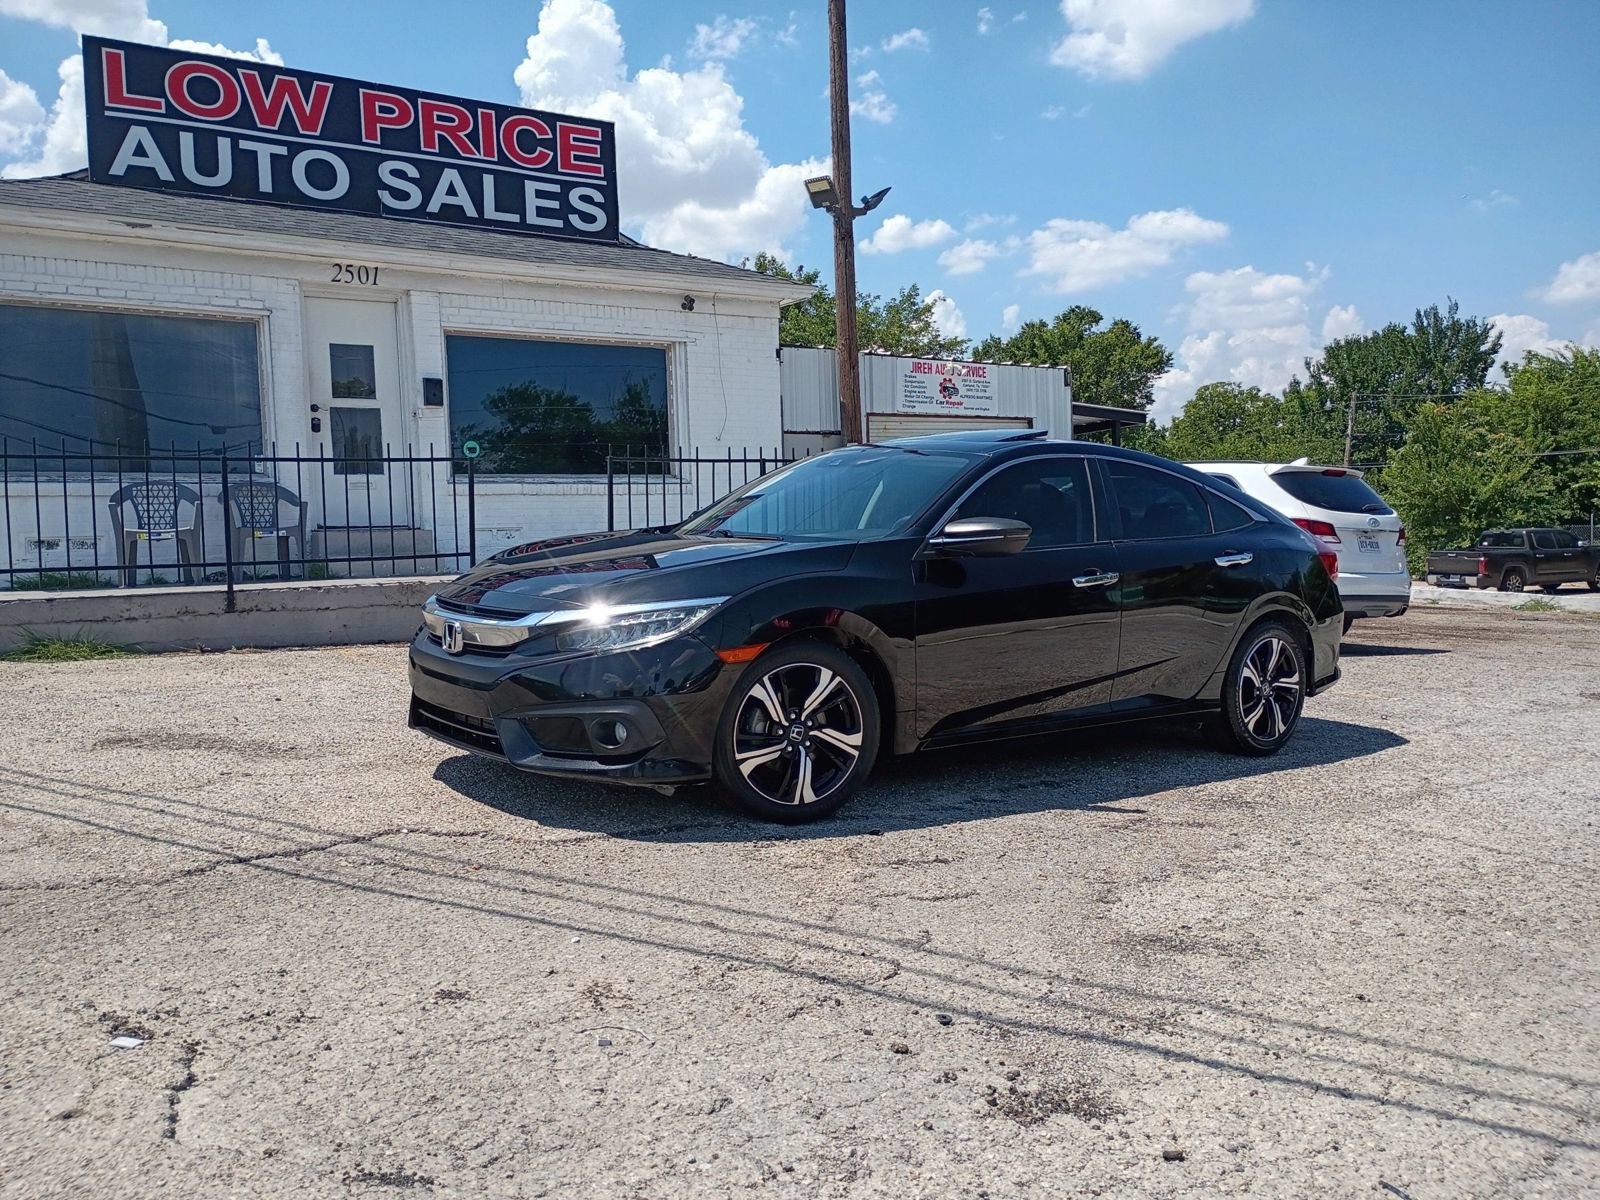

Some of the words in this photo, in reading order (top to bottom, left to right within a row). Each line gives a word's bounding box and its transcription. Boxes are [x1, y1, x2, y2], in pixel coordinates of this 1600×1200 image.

[101, 47, 334, 136] LOW
[359, 88, 604, 177] PRICE
[108, 125, 350, 200] AUTO
[377, 160, 607, 232] SALES
[331, 263, 379, 285] 2501
[910, 361, 932, 374] JIREH
[935, 363, 954, 376] AU
